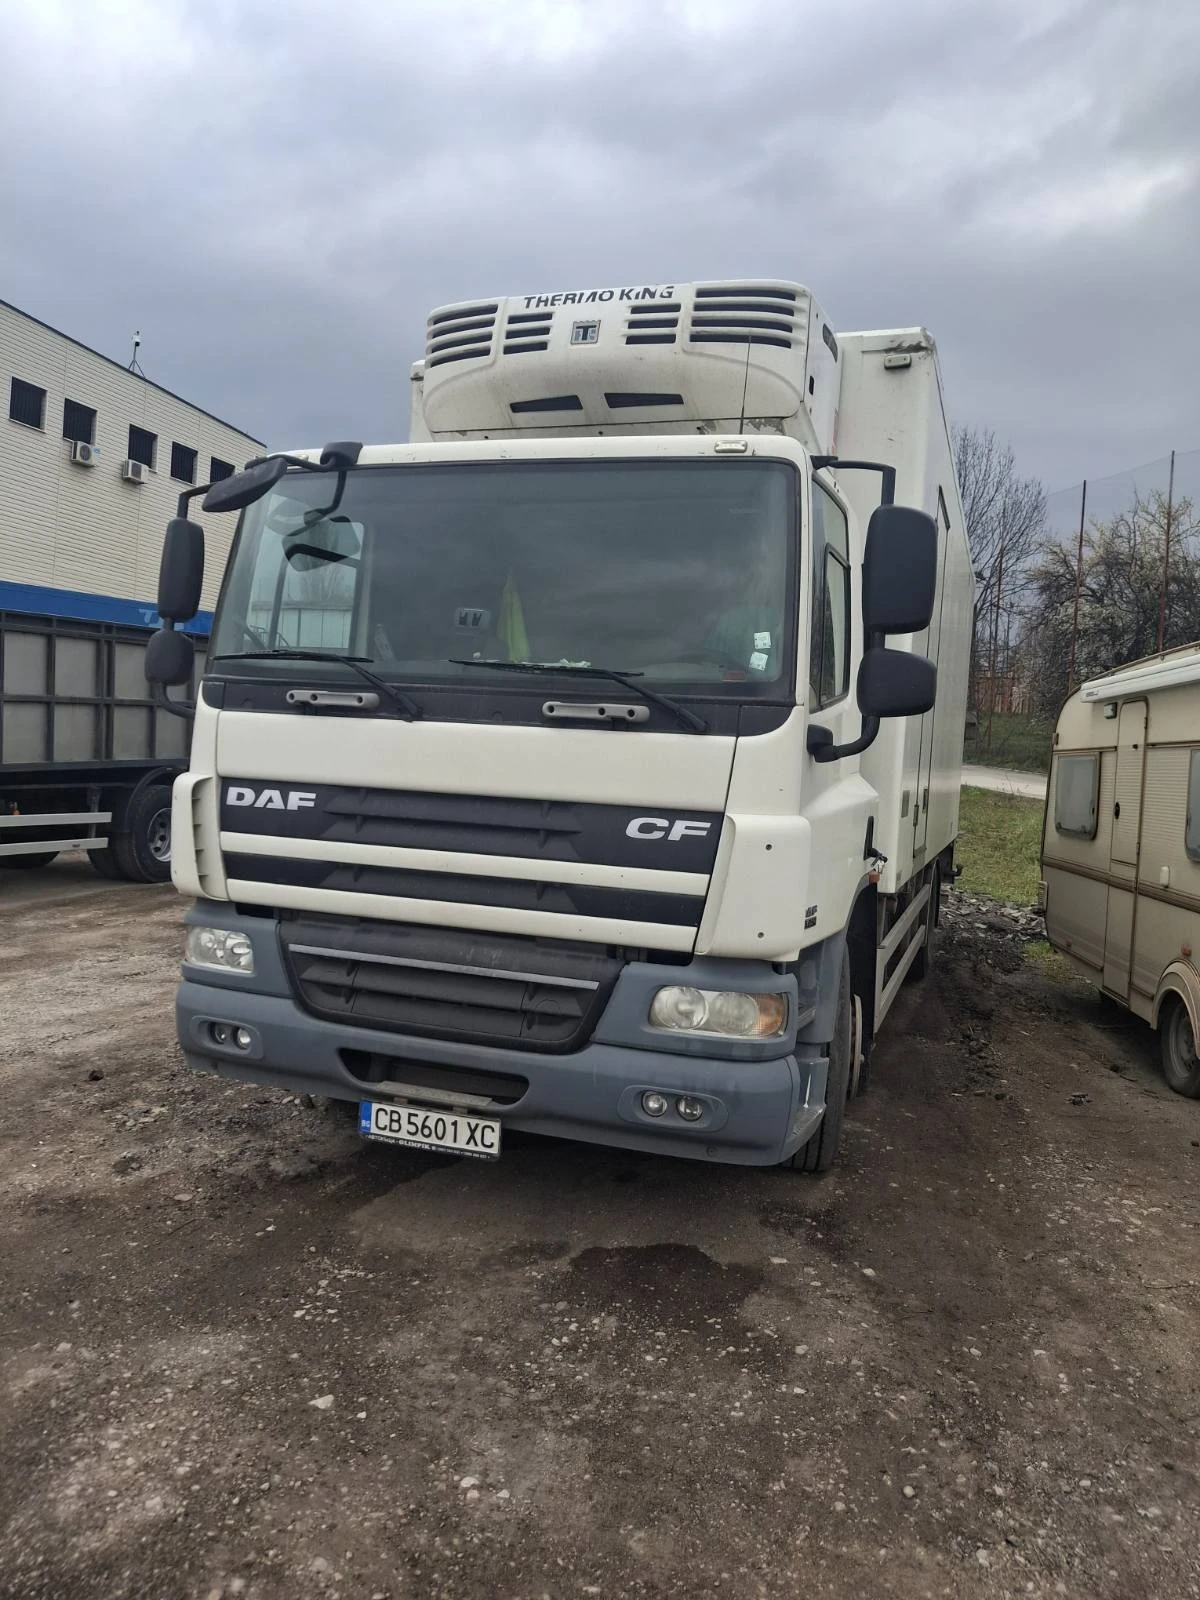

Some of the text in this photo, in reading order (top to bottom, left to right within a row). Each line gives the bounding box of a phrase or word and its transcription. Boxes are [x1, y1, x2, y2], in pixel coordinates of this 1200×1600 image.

[619, 286, 675, 301] KING
[225, 786, 317, 811] DAF
[625, 817, 713, 841] CF
[375, 1107, 495, 1149] CB 5601 XC
